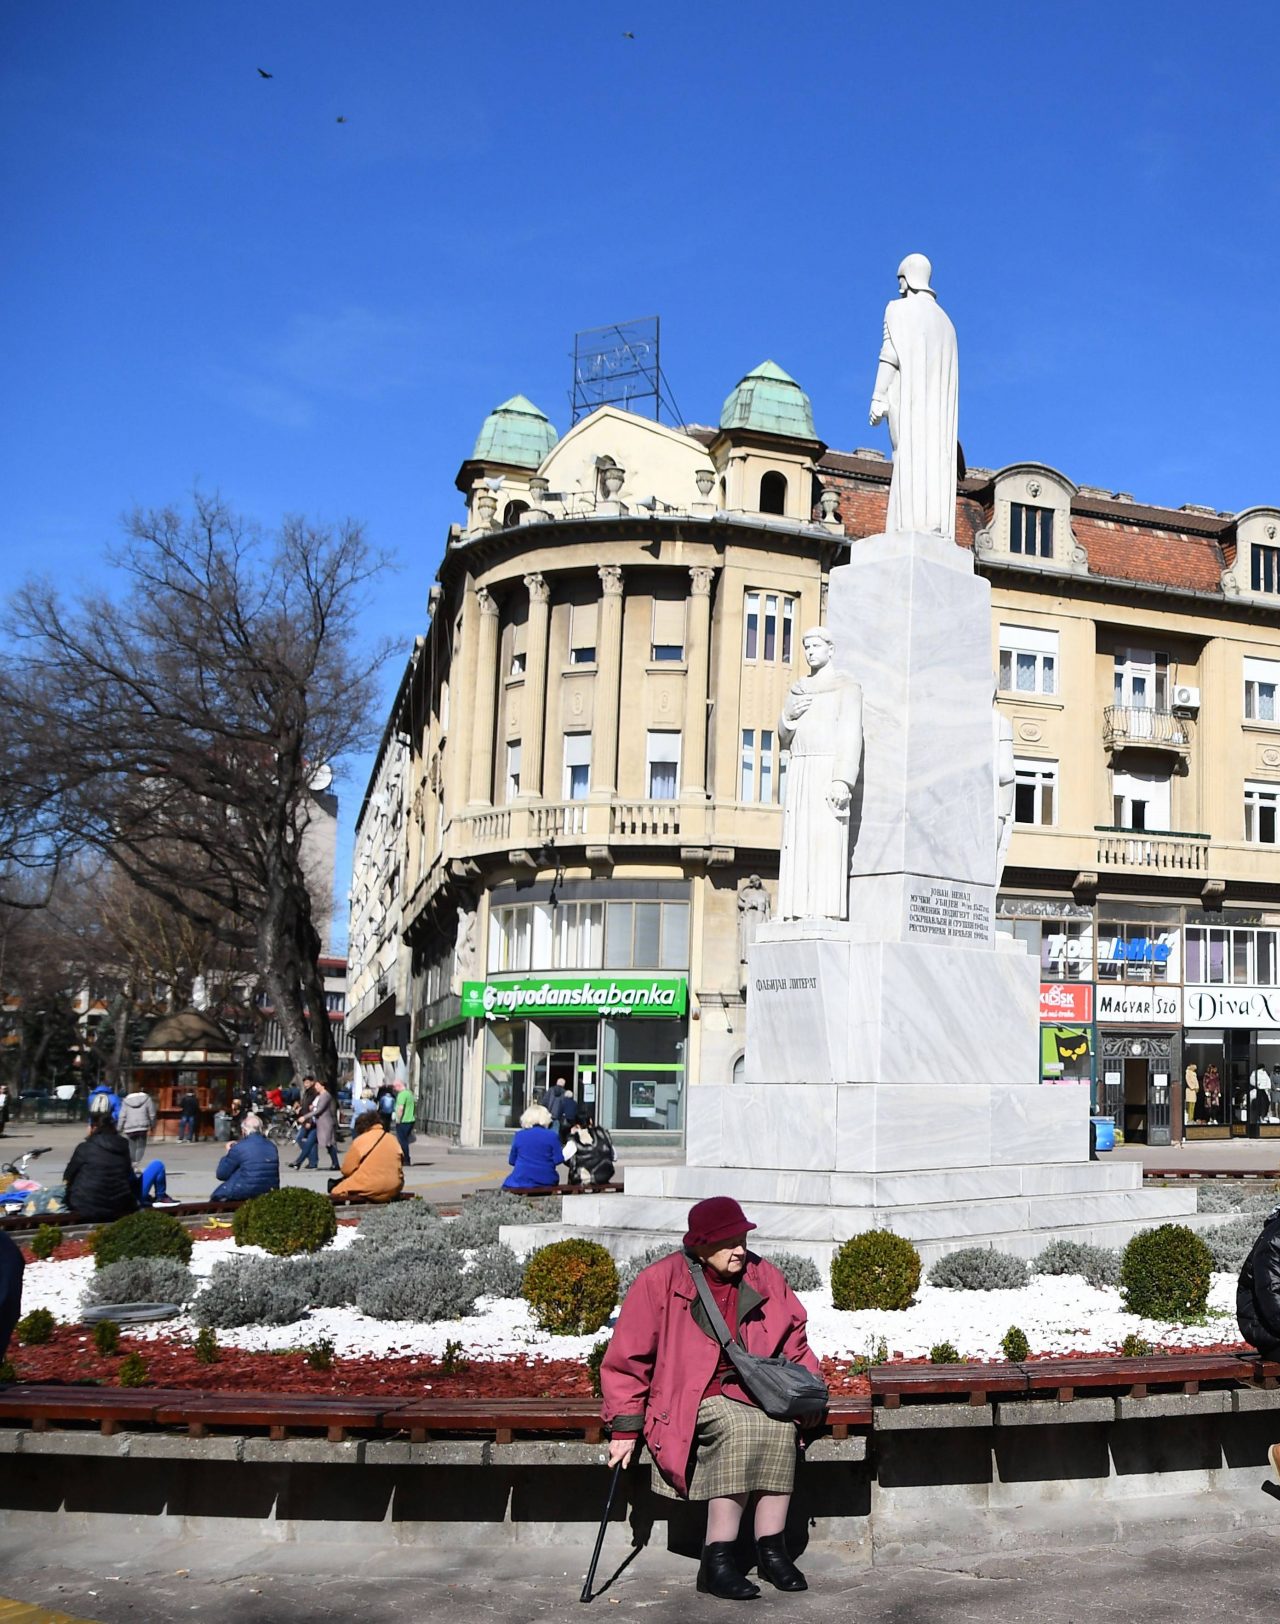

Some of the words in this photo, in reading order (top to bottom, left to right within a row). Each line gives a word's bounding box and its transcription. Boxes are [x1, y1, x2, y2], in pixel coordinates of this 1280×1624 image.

[909, 903, 941, 916] СПОМЕНИК
[755, 978, 787, 993] ФАБИЈАН
[789, 977, 817, 990] ЛИТЕРАТ
